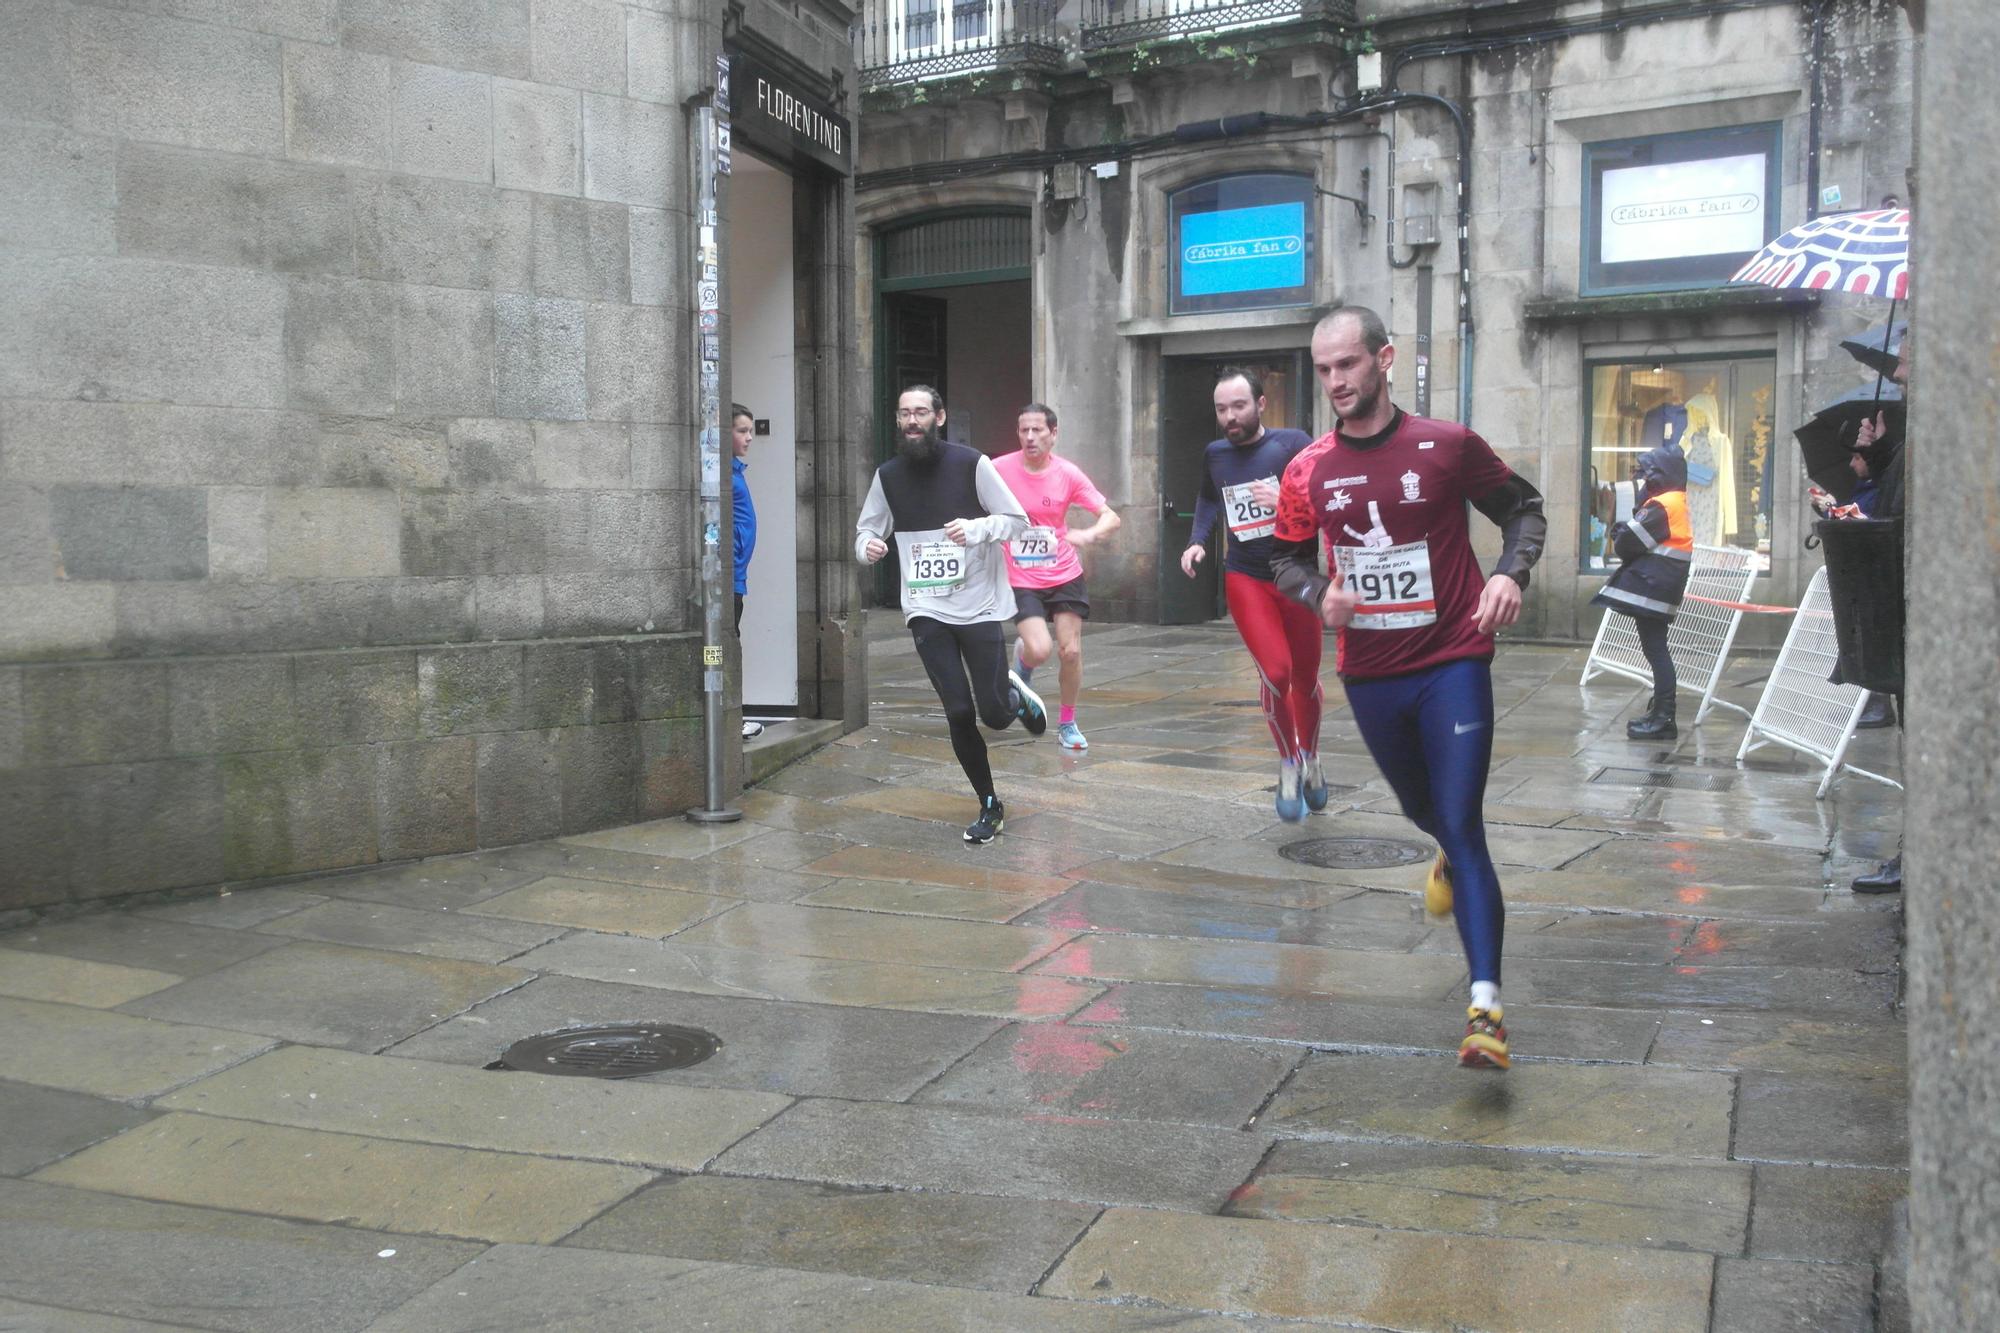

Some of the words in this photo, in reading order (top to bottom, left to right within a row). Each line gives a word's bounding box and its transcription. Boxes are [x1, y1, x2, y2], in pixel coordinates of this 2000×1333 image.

[757, 78, 841, 155] FLORENTINO
[1699, 201, 1732, 213] fan
[1252, 241, 1281, 253] fan
[1020, 539, 1048, 554] 773
[914, 559, 959, 579] 1339
[1348, 571, 1419, 601] 1912
